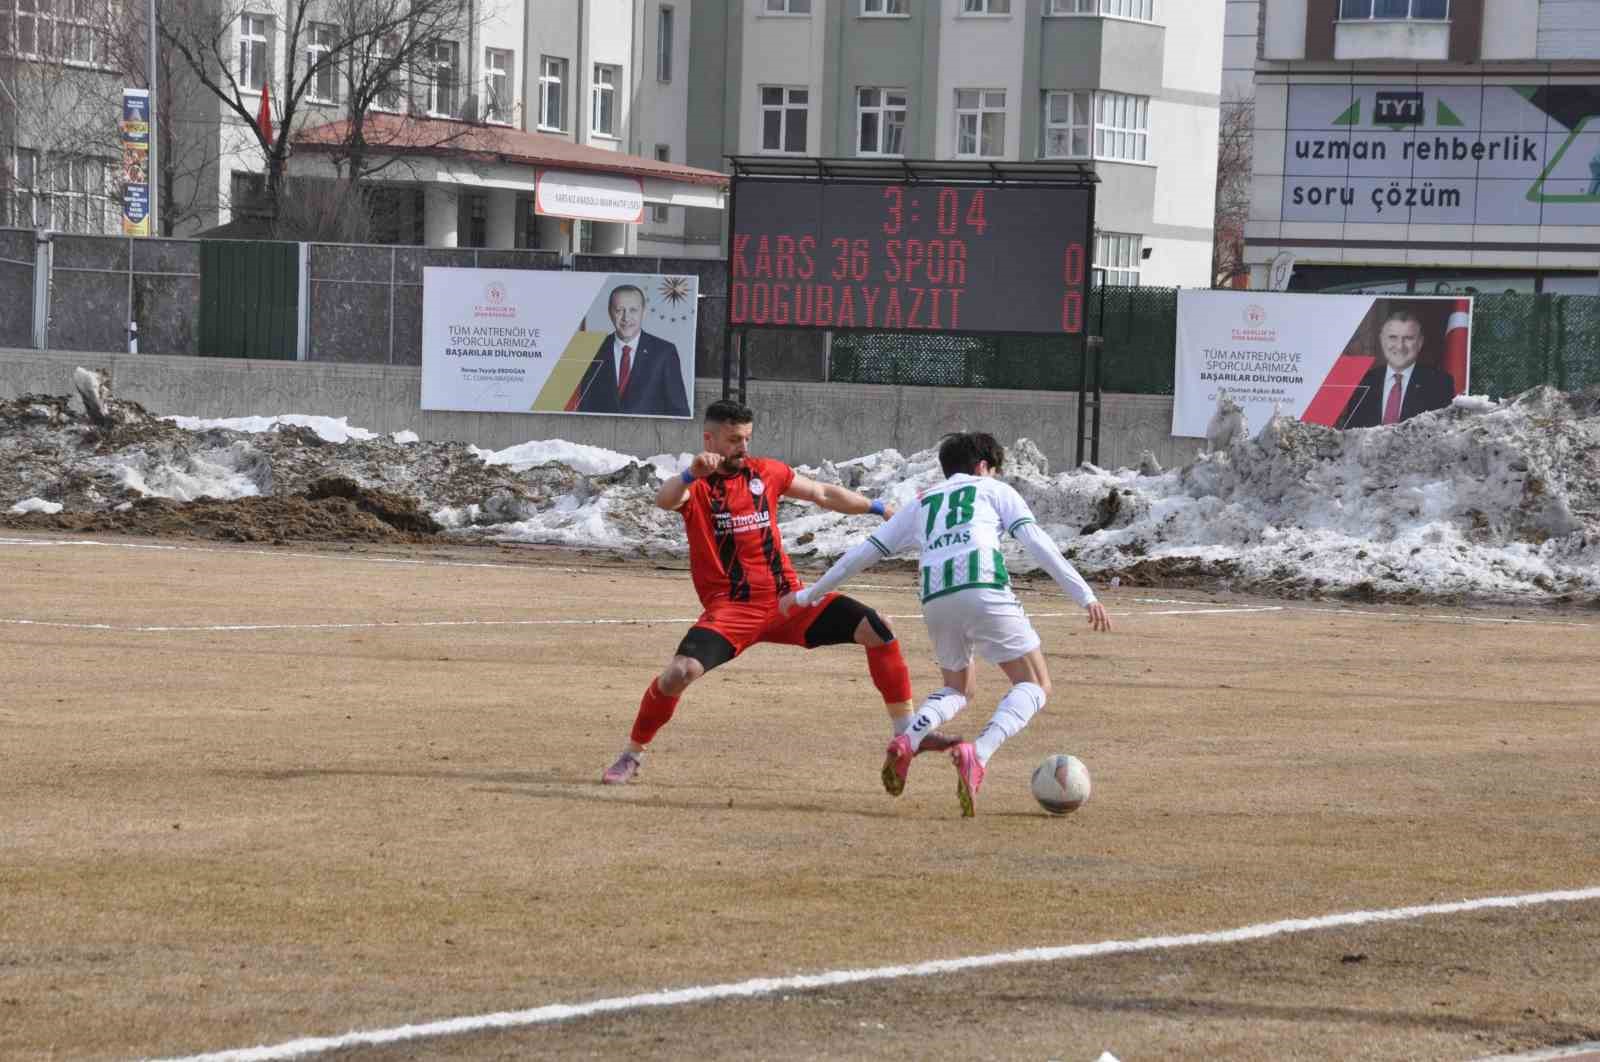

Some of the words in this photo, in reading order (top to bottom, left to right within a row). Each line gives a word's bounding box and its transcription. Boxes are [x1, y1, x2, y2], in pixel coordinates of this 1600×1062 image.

[1377, 98, 1420, 116] TYT
[1294, 139, 1387, 161] uzman
[1402, 134, 1538, 162] rehberlik
[1291, 184, 1355, 206] soru
[1371, 181, 1462, 213] çözüm
[732, 234, 816, 281] KARS
[831, 238, 871, 281] 36
[884, 239, 969, 284] SPOR
[1064, 242, 1085, 285] 0
[730, 283, 965, 330] DOGUBAYAZIT
[1062, 290, 1083, 333] 0
[449, 325, 471, 337] TÜM
[473, 326, 526, 338] ANTRENÖR
[528, 327, 541, 338] VE
[451, 335, 537, 348] SPORCULARIMIZA
[445, 347, 493, 358] BAŞARILAR
[494, 348, 543, 359] DİLİYORUM
[1204, 348, 1227, 360] TÜM
[1230, 350, 1286, 363] ANTRENÖR
[1288, 352, 1303, 363] VE
[1206, 359, 1298, 374] SPORCULARIMIZA
[1200, 372, 1251, 383] BAŞARILAR
[921, 485, 977, 541] 78
